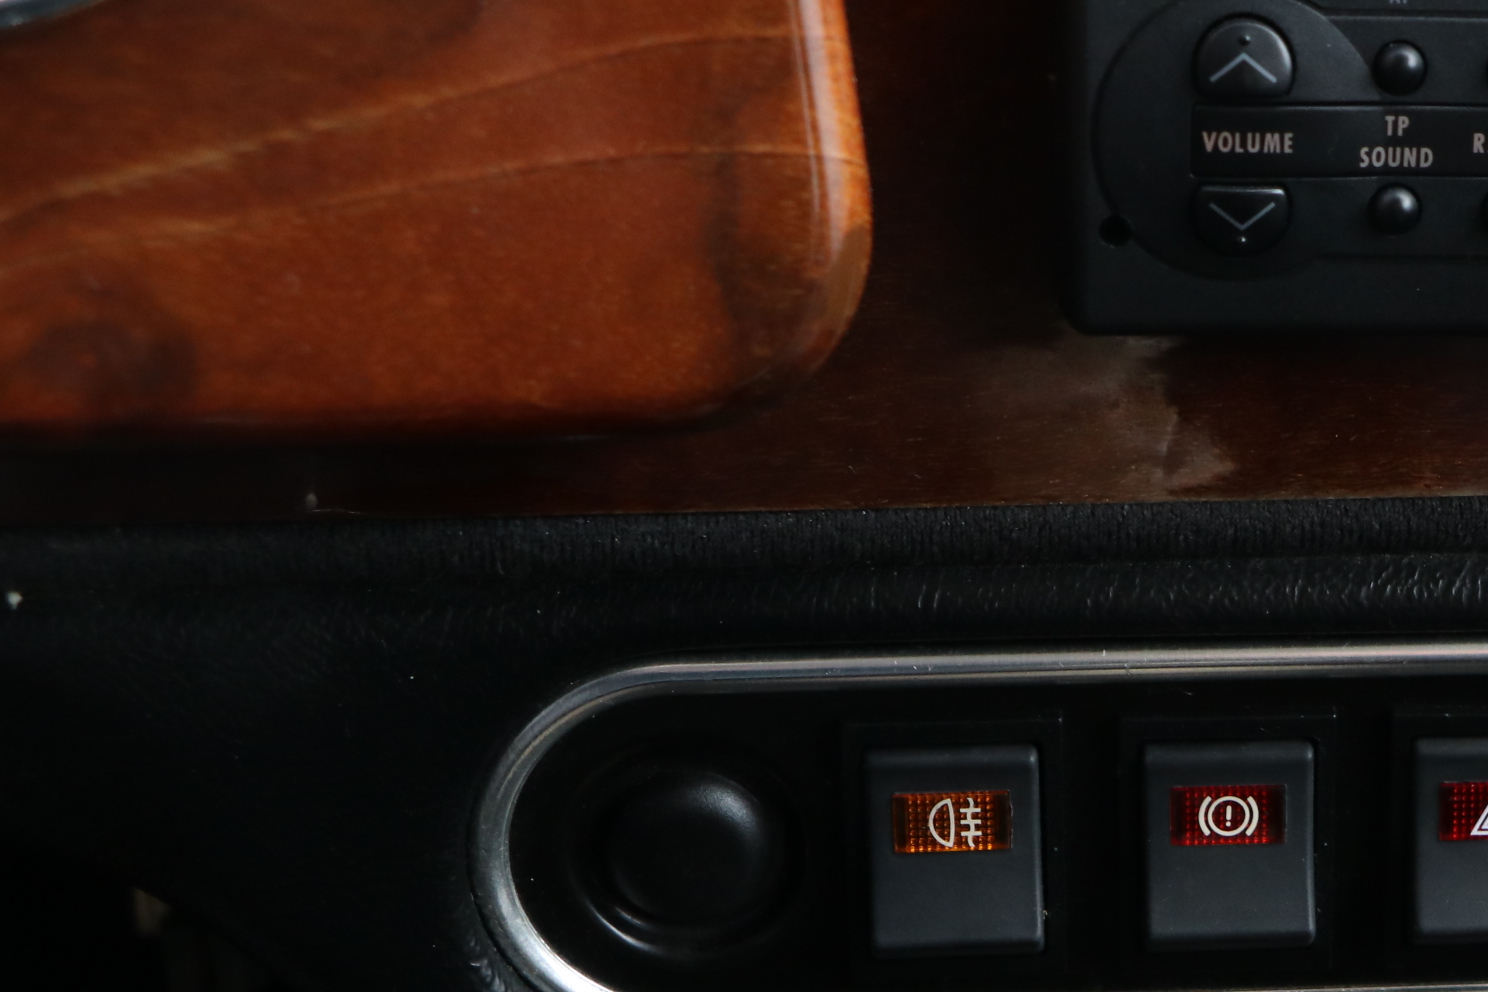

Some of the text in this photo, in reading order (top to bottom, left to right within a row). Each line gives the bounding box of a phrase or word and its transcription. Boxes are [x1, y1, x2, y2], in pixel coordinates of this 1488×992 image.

[1384, 115, 1410, 138] TP
[1202, 130, 1294, 154] VOLUME
[1359, 147, 1434, 169] SOUND
